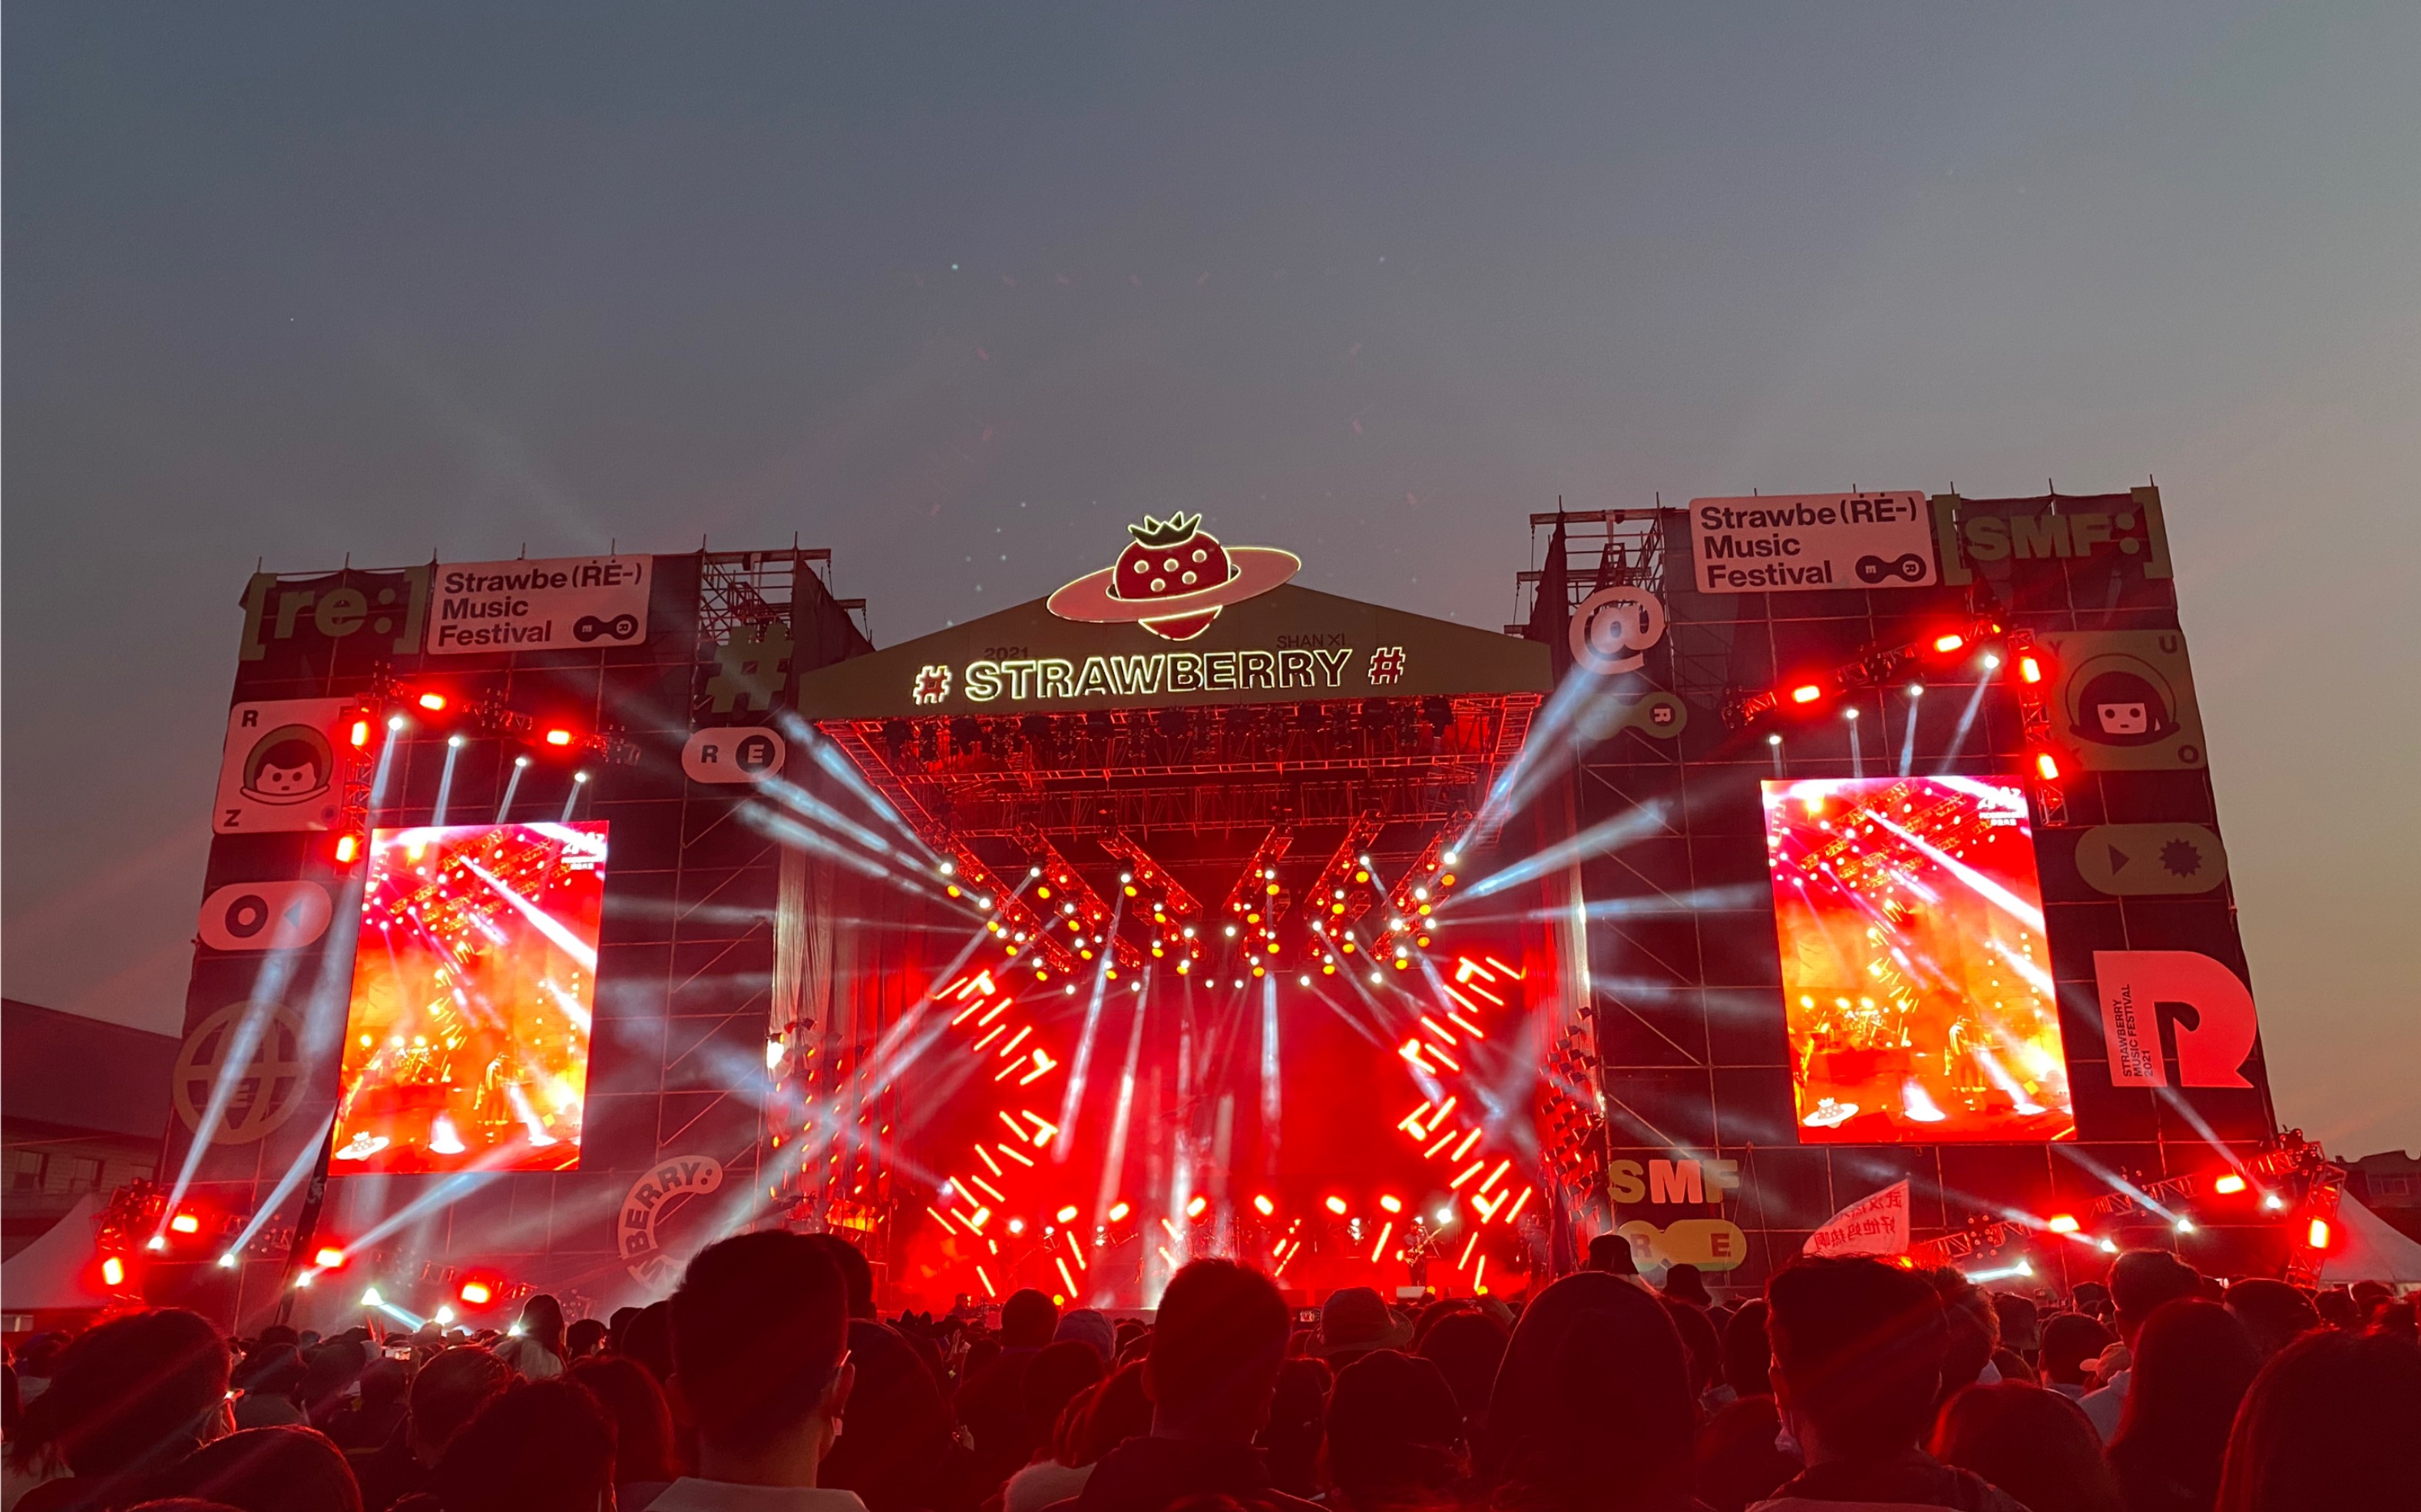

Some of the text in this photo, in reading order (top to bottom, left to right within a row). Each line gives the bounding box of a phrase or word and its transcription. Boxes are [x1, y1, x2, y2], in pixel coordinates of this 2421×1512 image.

[1704, 534, 1801, 559] Music
[1707, 560, 1834, 588] Festival
[442, 596, 529, 620] Music
[438, 620, 552, 647] Festival
[2158, 634, 2178, 654] U
[984, 647, 1028, 660] 2021
[1276, 634, 1324, 649] SHAN
[964, 649, 1353, 702] STRAWBERRY
[241, 710, 258, 727] R
[700, 744, 765, 763] R E
[2178, 745, 2199, 764] O
[223, 809, 241, 827] Z
[2112, 999, 2132, 1077] STRAWBERRY
[2121, 983, 2144, 1077] MUSIC FESTIVAL
[2141, 1050, 2153, 1077] 2021
[1607, 1160, 1740, 1204] SMF
[1630, 1233, 1731, 1258] R E
